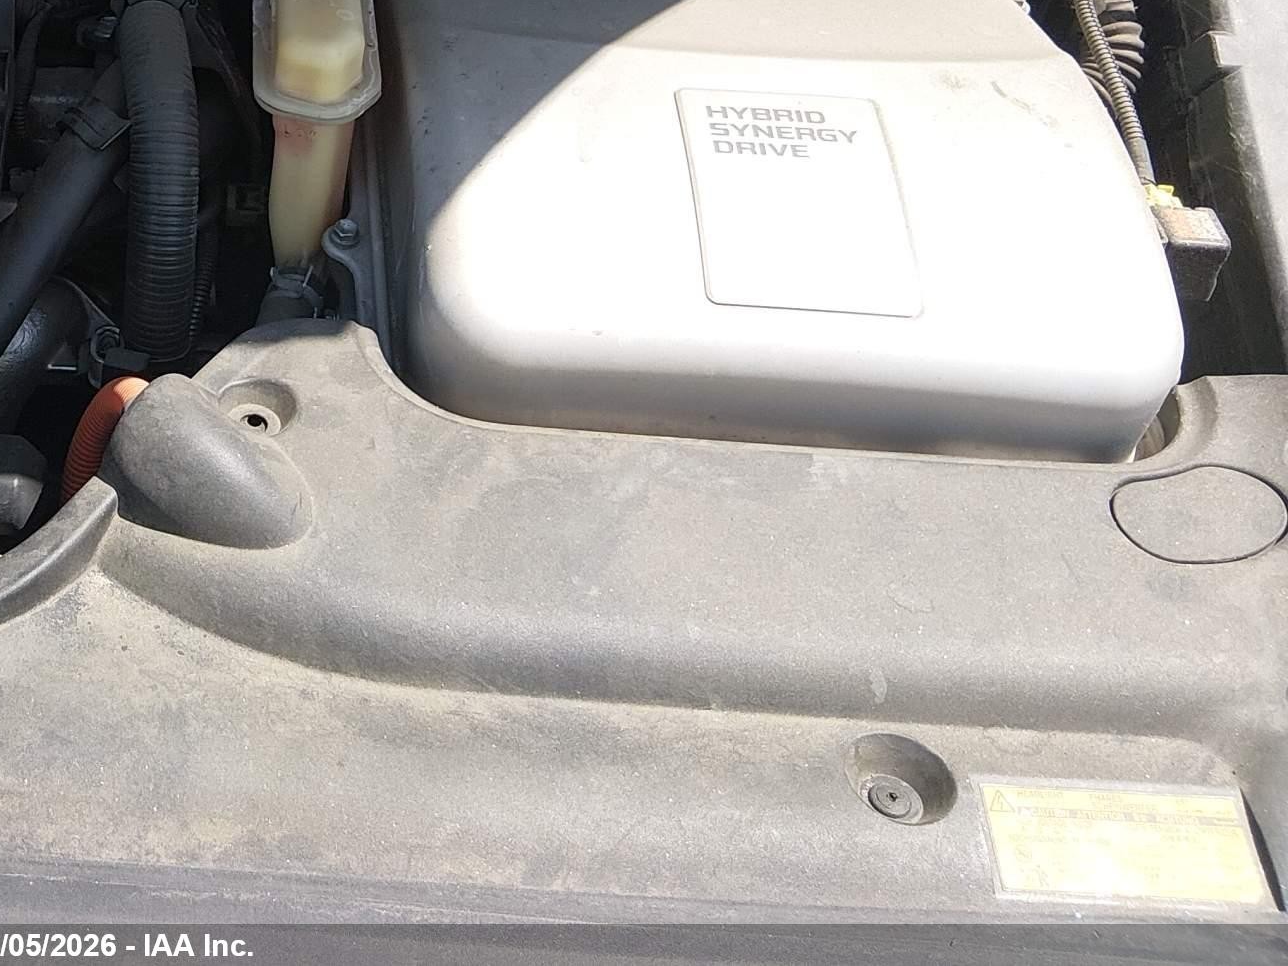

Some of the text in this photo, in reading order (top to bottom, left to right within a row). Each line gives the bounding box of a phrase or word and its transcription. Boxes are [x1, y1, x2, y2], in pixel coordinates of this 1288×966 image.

[706, 105, 826, 125] HYBRID
[709, 122, 858, 145] SYNERGY
[713, 140, 810, 159] DRIVE
